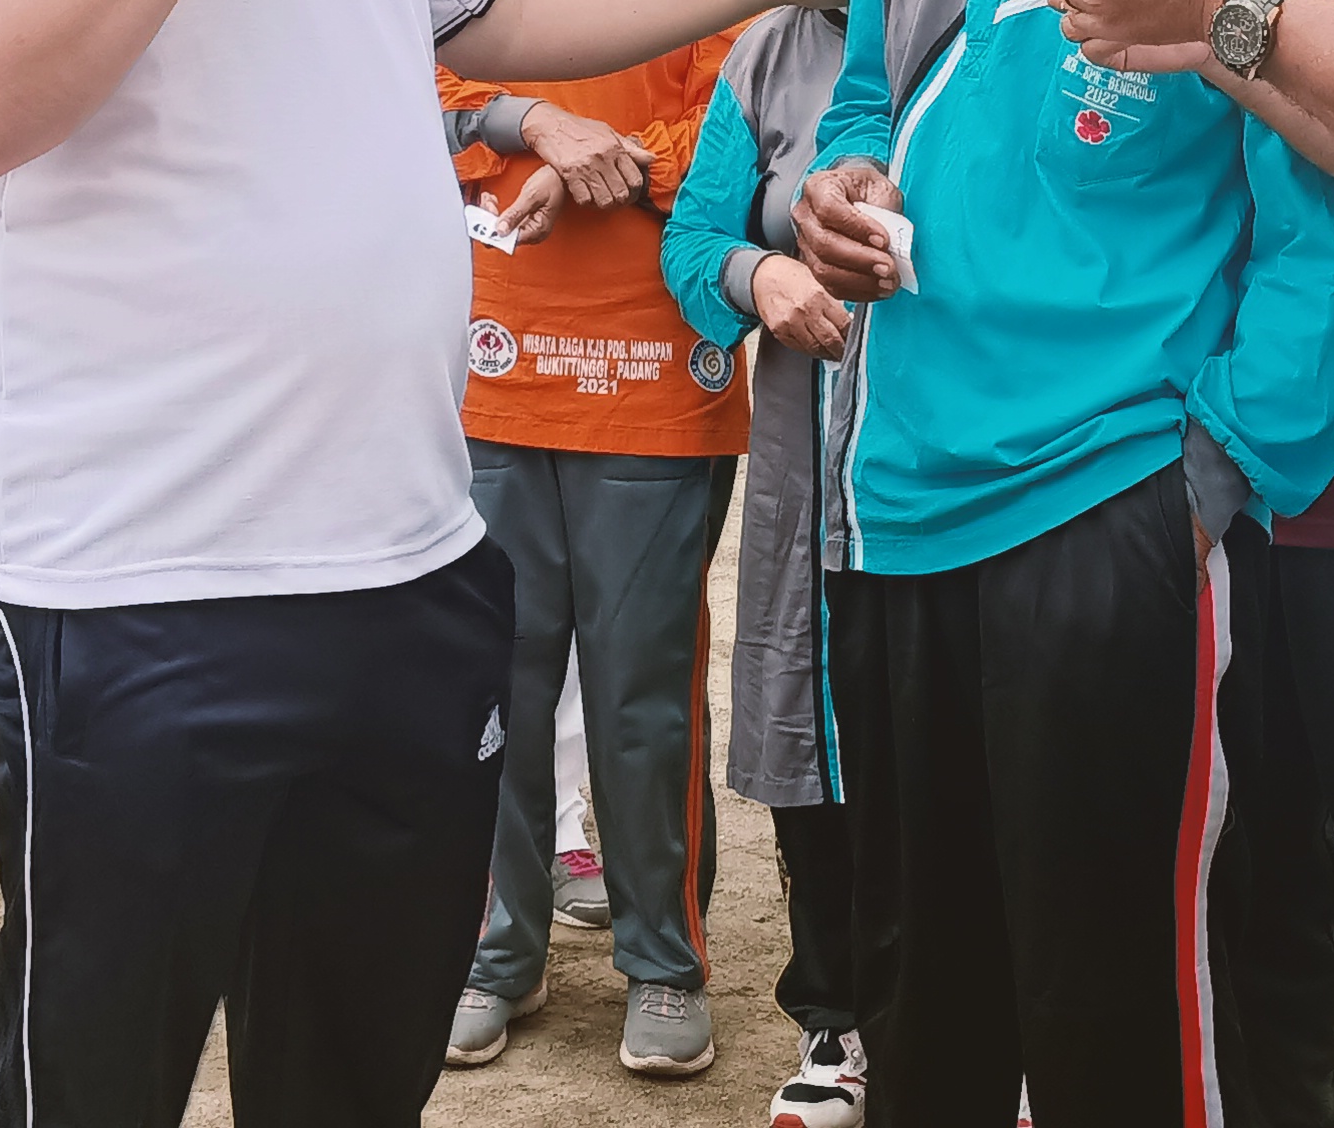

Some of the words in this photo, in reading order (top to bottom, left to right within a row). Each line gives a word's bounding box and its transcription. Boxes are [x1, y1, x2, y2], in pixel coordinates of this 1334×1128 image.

[1085, 85, 1119, 109] 2022
[1108, 75, 1157, 102] BENGKULU
[523, 334, 556, 355] WISATA
[558, 337, 584, 357] RAGA
[587, 339, 605, 358] KJS
[630, 340, 673, 361] HARAPAN
[536, 356, 608, 378] BUKITTINGGI
[617, 361, 660, 380] PADANG
[576, 378, 618, 395] 2021
